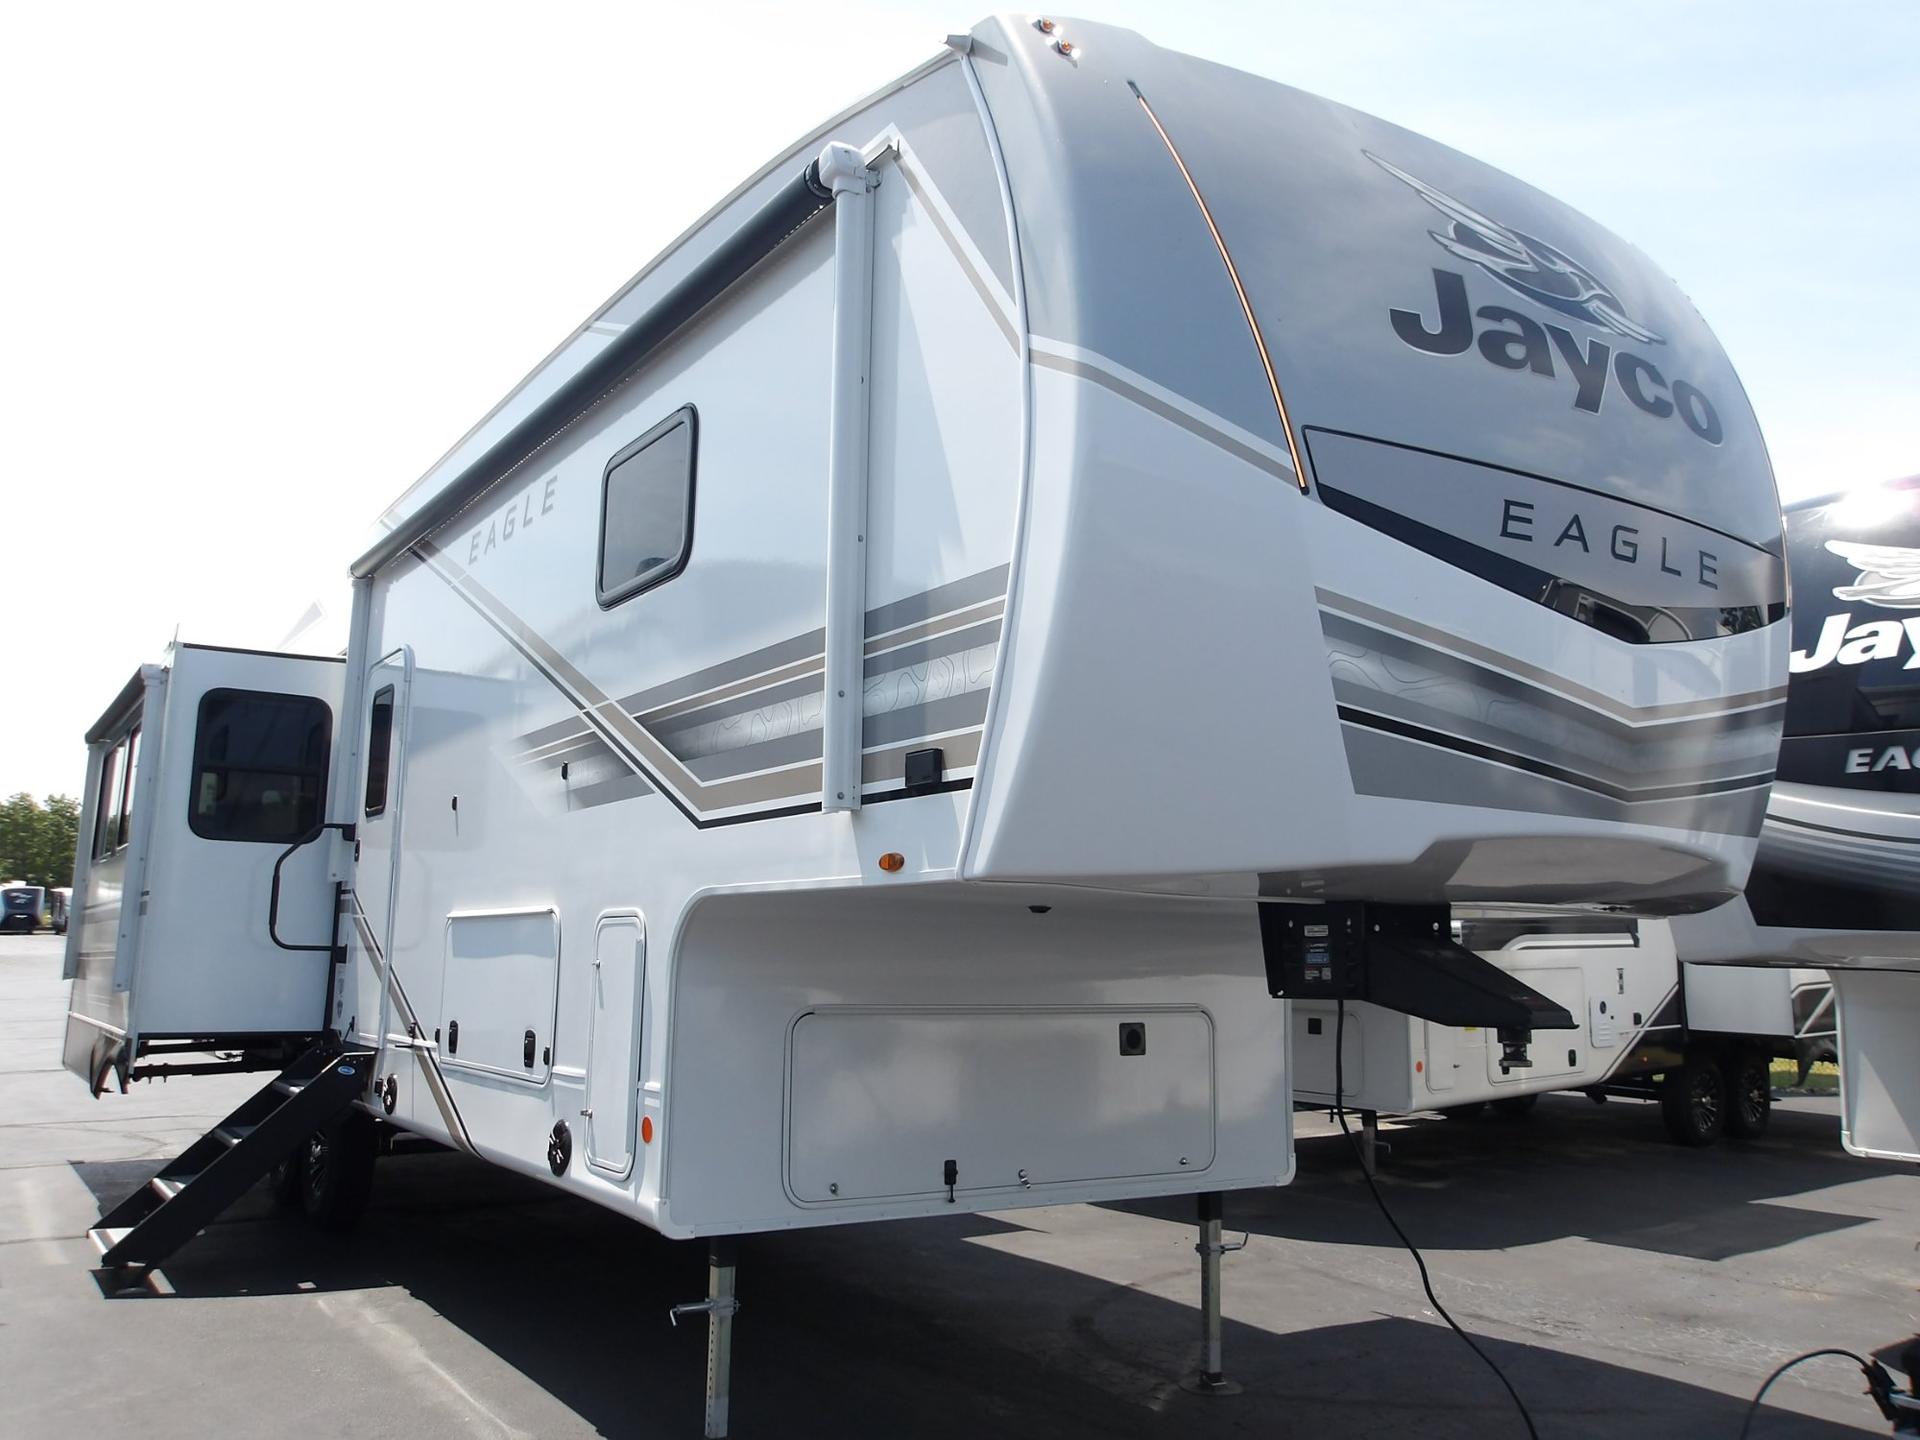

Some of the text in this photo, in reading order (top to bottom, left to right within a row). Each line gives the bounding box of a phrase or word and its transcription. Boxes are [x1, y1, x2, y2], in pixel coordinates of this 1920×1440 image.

[1388, 268, 1723, 446] Jayco
[468, 474, 558, 566] EAGLE
[1500, 499, 1718, 590] EAGLE
[1845, 745, 1920, 773] EA
